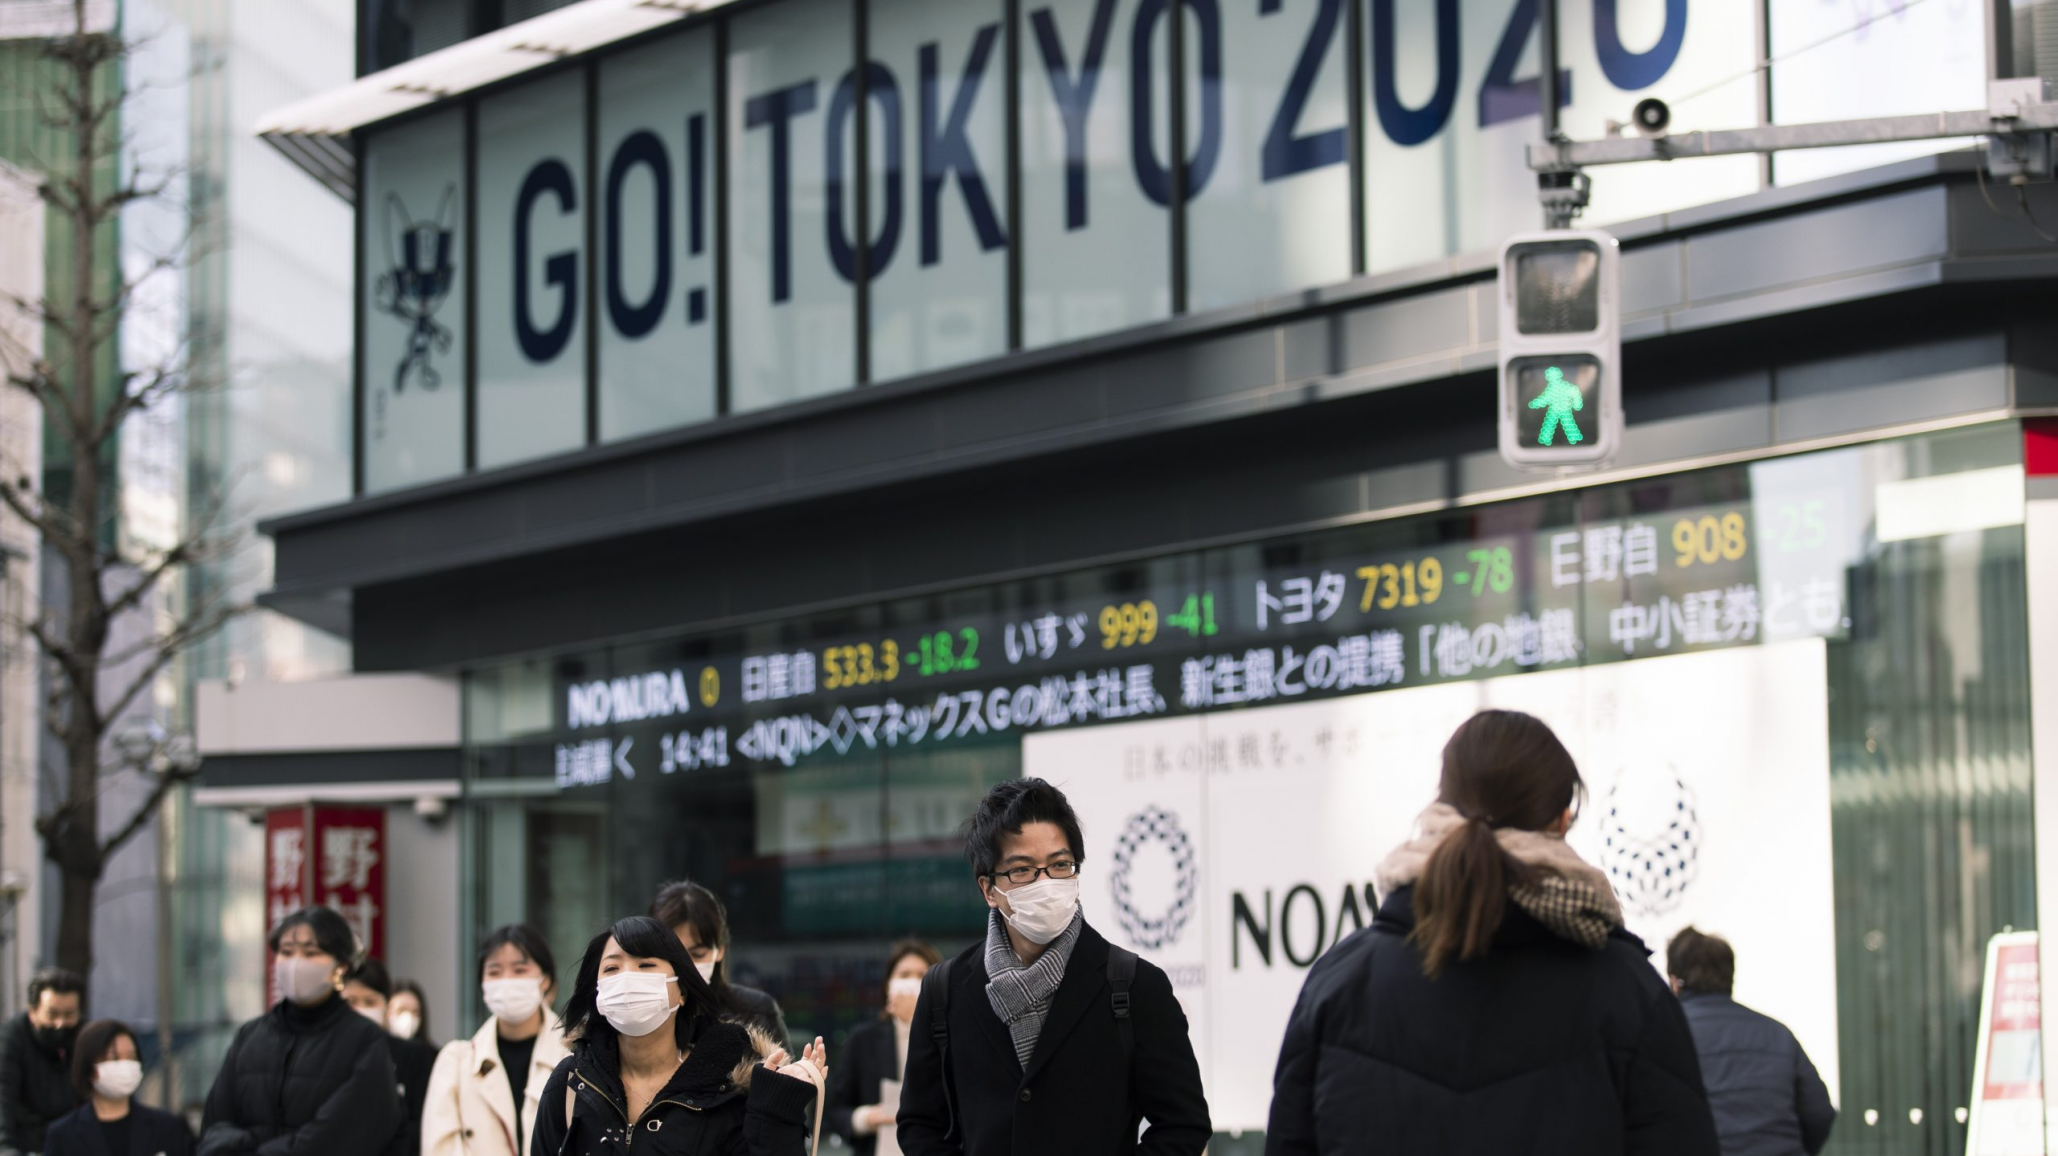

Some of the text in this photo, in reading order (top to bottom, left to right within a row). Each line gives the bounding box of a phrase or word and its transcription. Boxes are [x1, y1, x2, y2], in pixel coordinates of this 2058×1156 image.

[513, 111, 708, 366] GO!
[745, 0, 1224, 304] TOKYO
[568, 668, 690, 730] NOMURA
[823, 638, 900, 690] 533.3
[904, 626, 980, 677] -18.2
[1099, 599, 1158, 650] 999
[1166, 591, 1218, 637] -41
[1256, 570, 1346, 631] トヨタ
[1356, 556, 1443, 613] 7319
[1453, 547, 1513, 598] -78
[1671, 512, 1746, 569] 908
